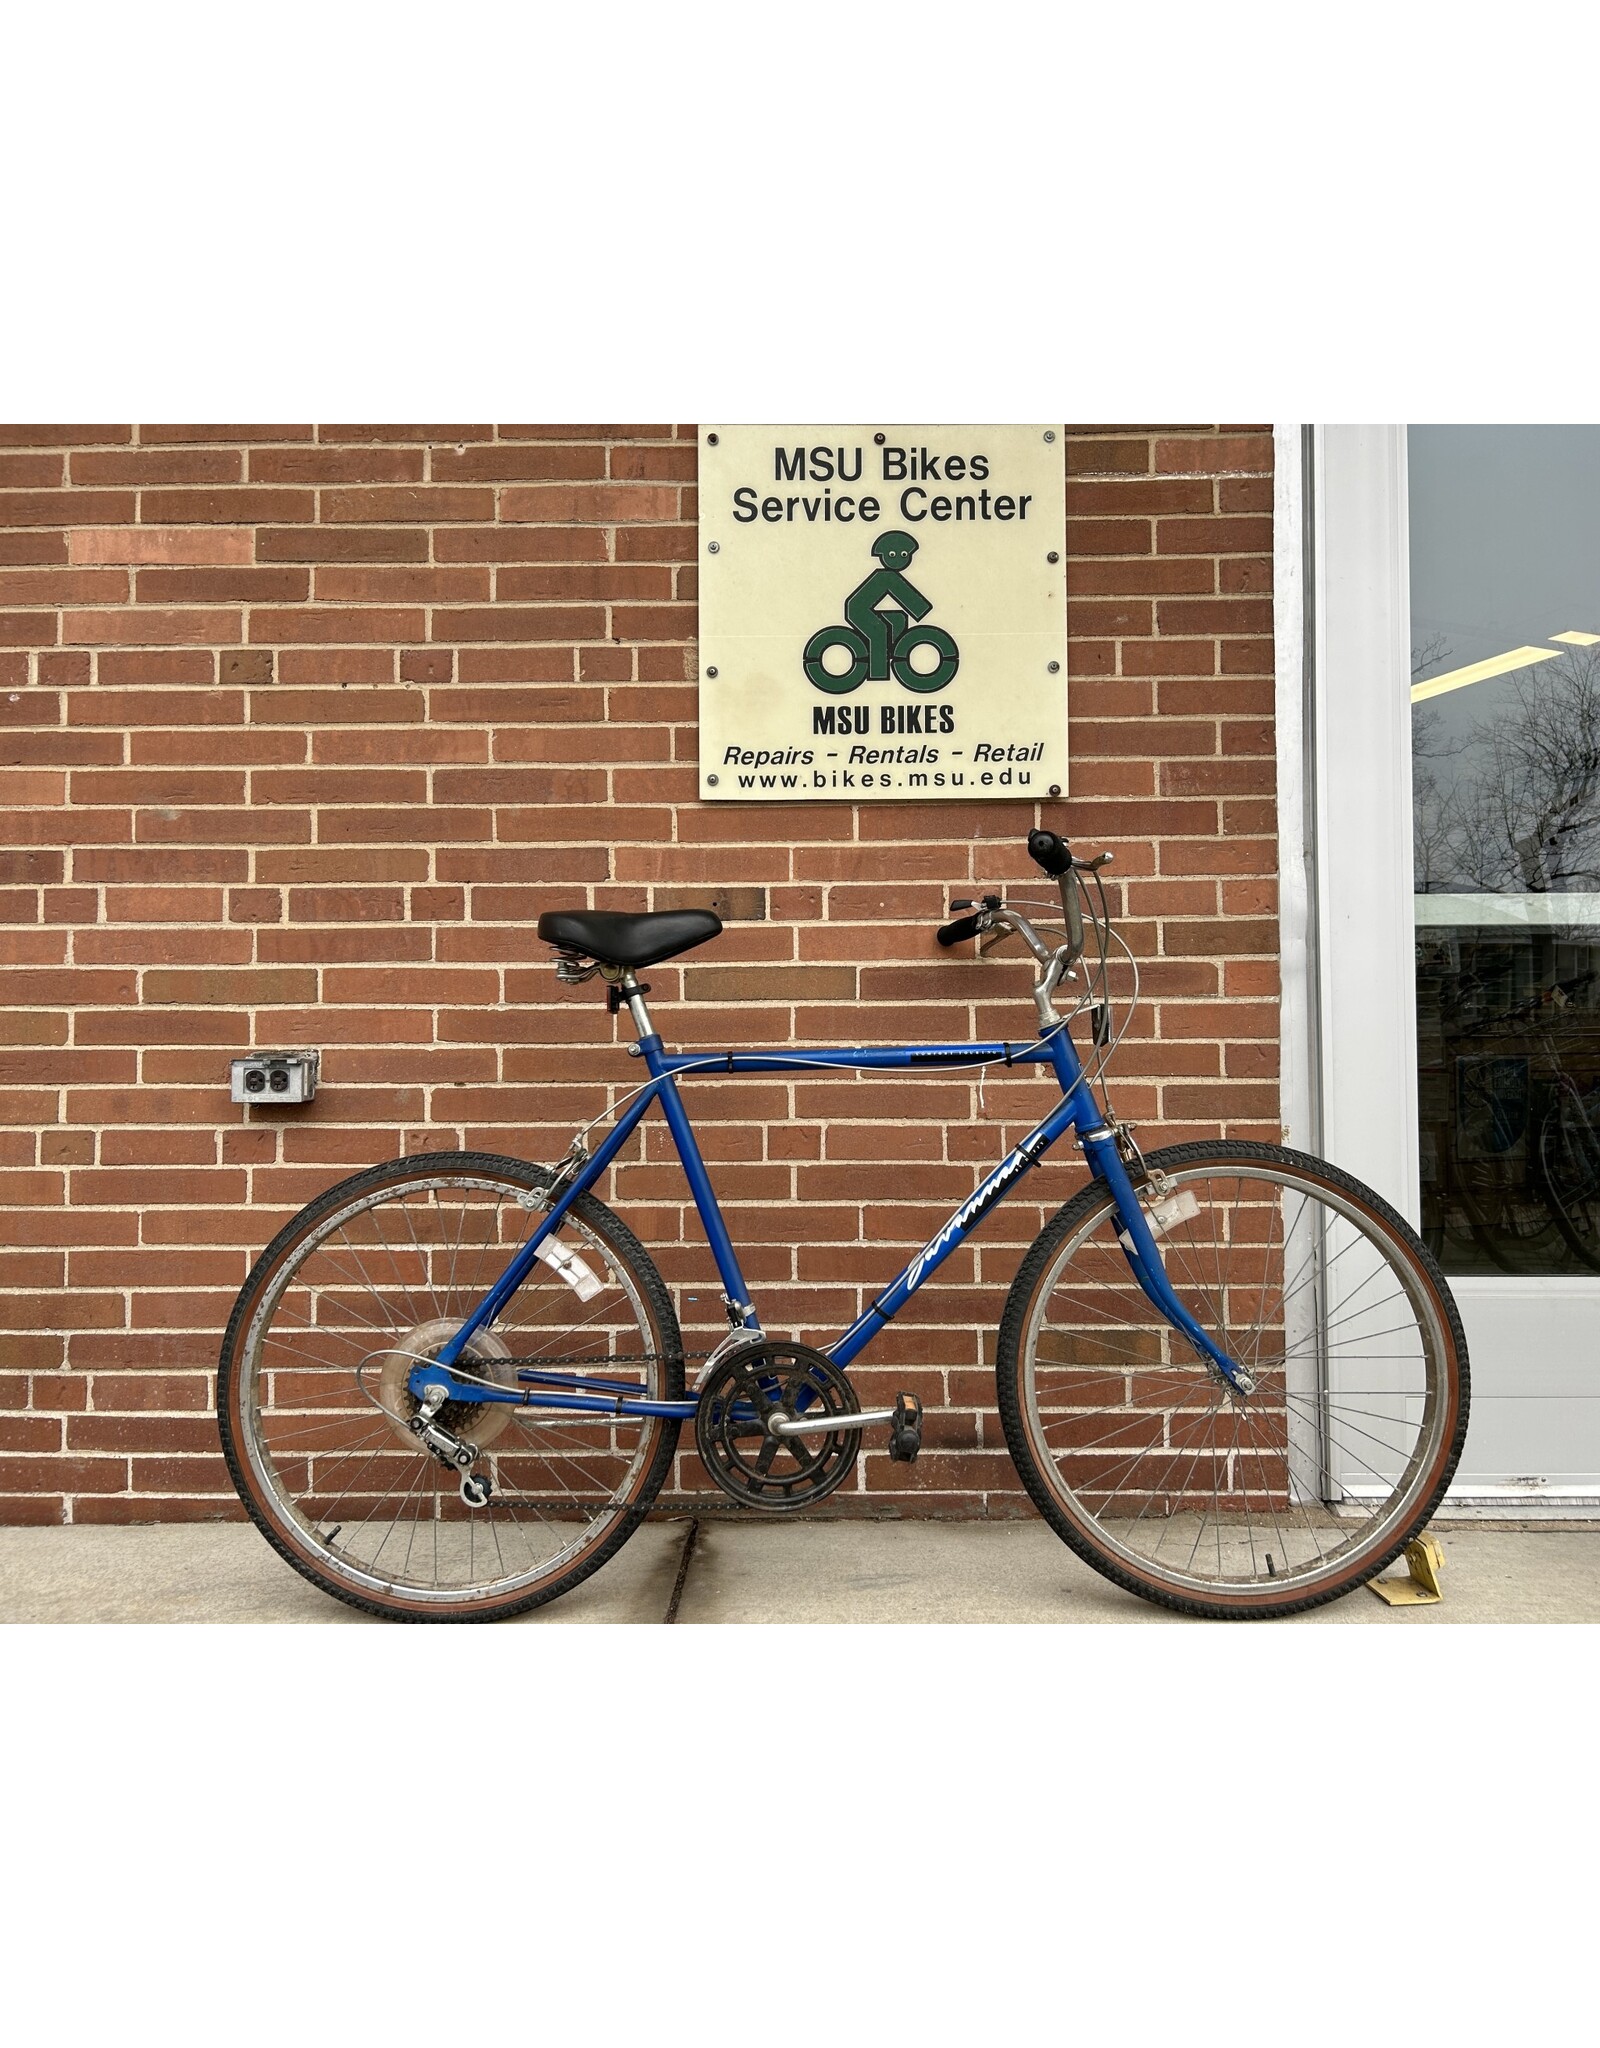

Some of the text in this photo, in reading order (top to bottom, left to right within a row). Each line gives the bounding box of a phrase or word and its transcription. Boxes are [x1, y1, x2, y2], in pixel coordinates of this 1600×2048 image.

[776, 447, 990, 481] MSU Bikes
[733, 487, 1031, 522] Service Center
[814, 705, 954, 734] MSU BIKES
[724, 747, 813, 768] Repairs
[849, 745, 938, 764] Rentals
[974, 743, 1044, 762] Retail
[738, 768, 1031, 788] www.bikes.msu.edu
